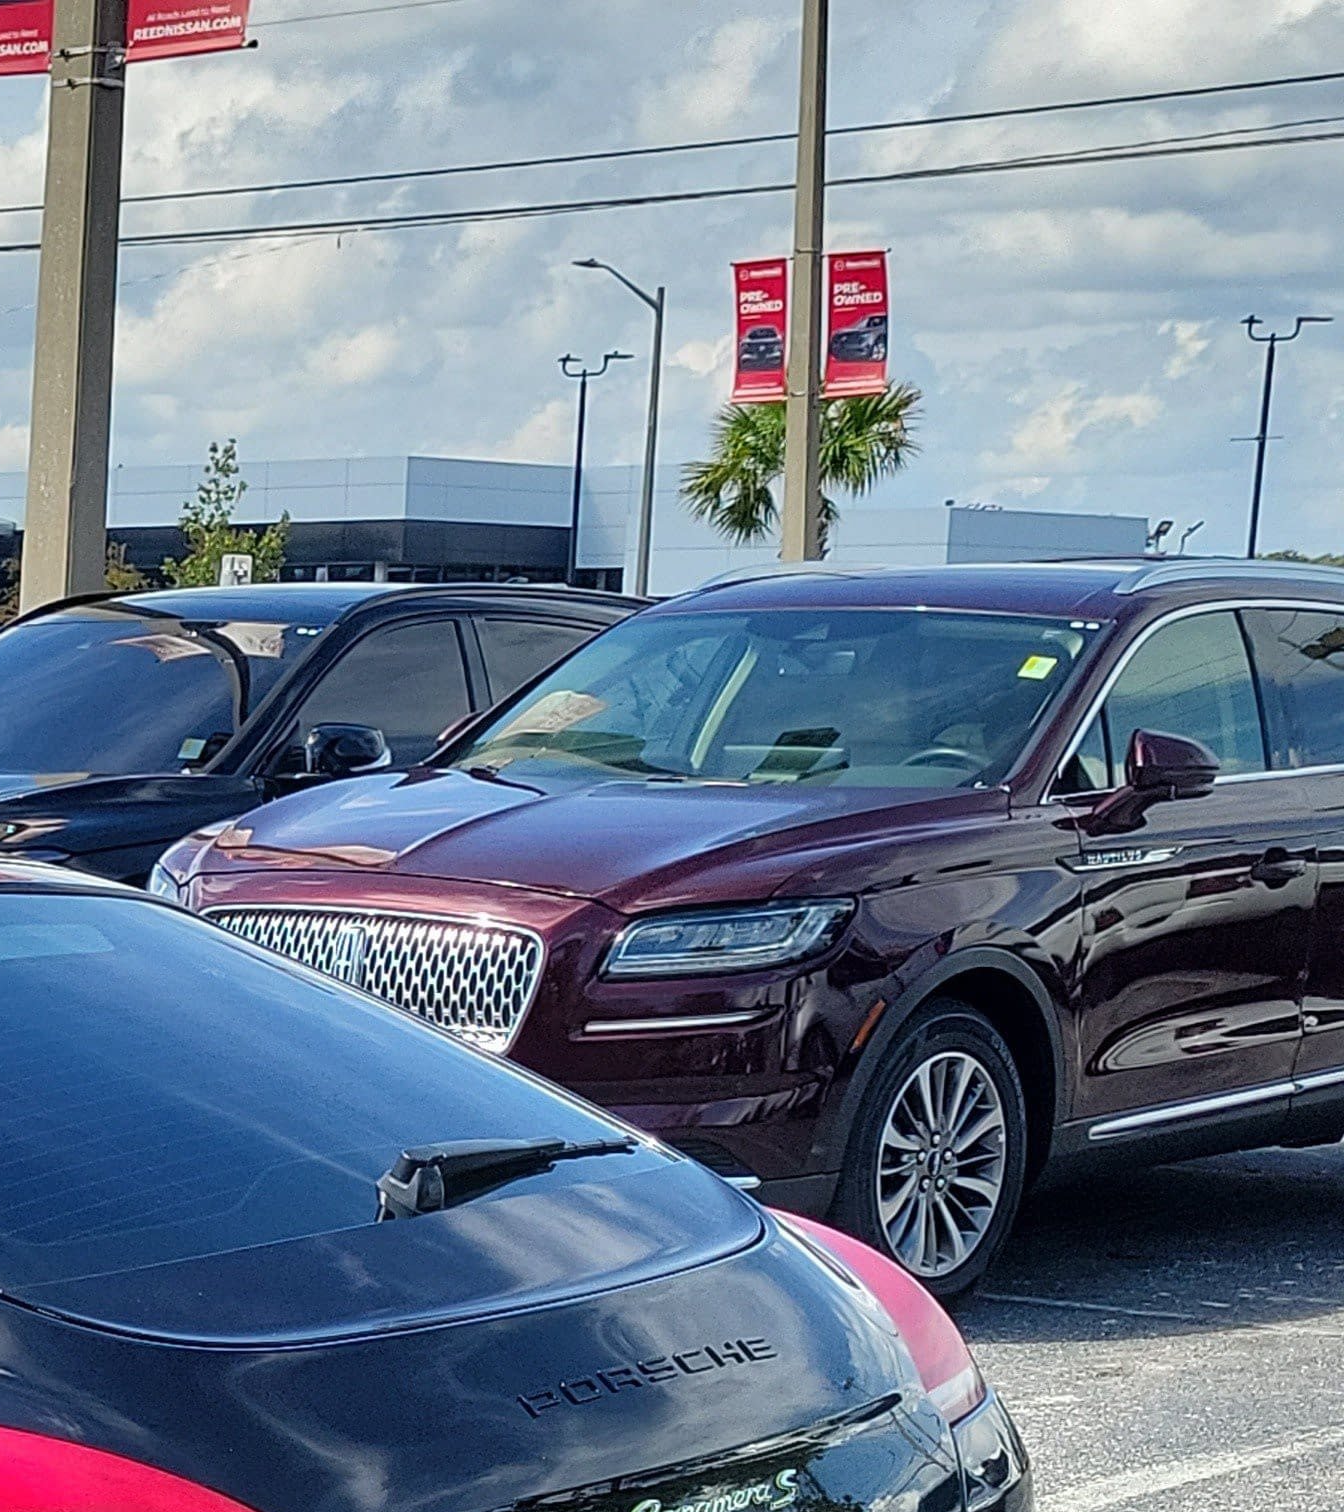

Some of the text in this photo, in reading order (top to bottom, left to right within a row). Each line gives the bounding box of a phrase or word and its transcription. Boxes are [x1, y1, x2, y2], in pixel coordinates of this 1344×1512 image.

[133, 16, 242, 41] REEDNISSAN.COM
[833, 292, 883, 306] OWNED
[834, 281, 867, 294] PRE-
[516, 1338, 778, 1420] PORSCHE
[769, 1468, 799, 1510] S
